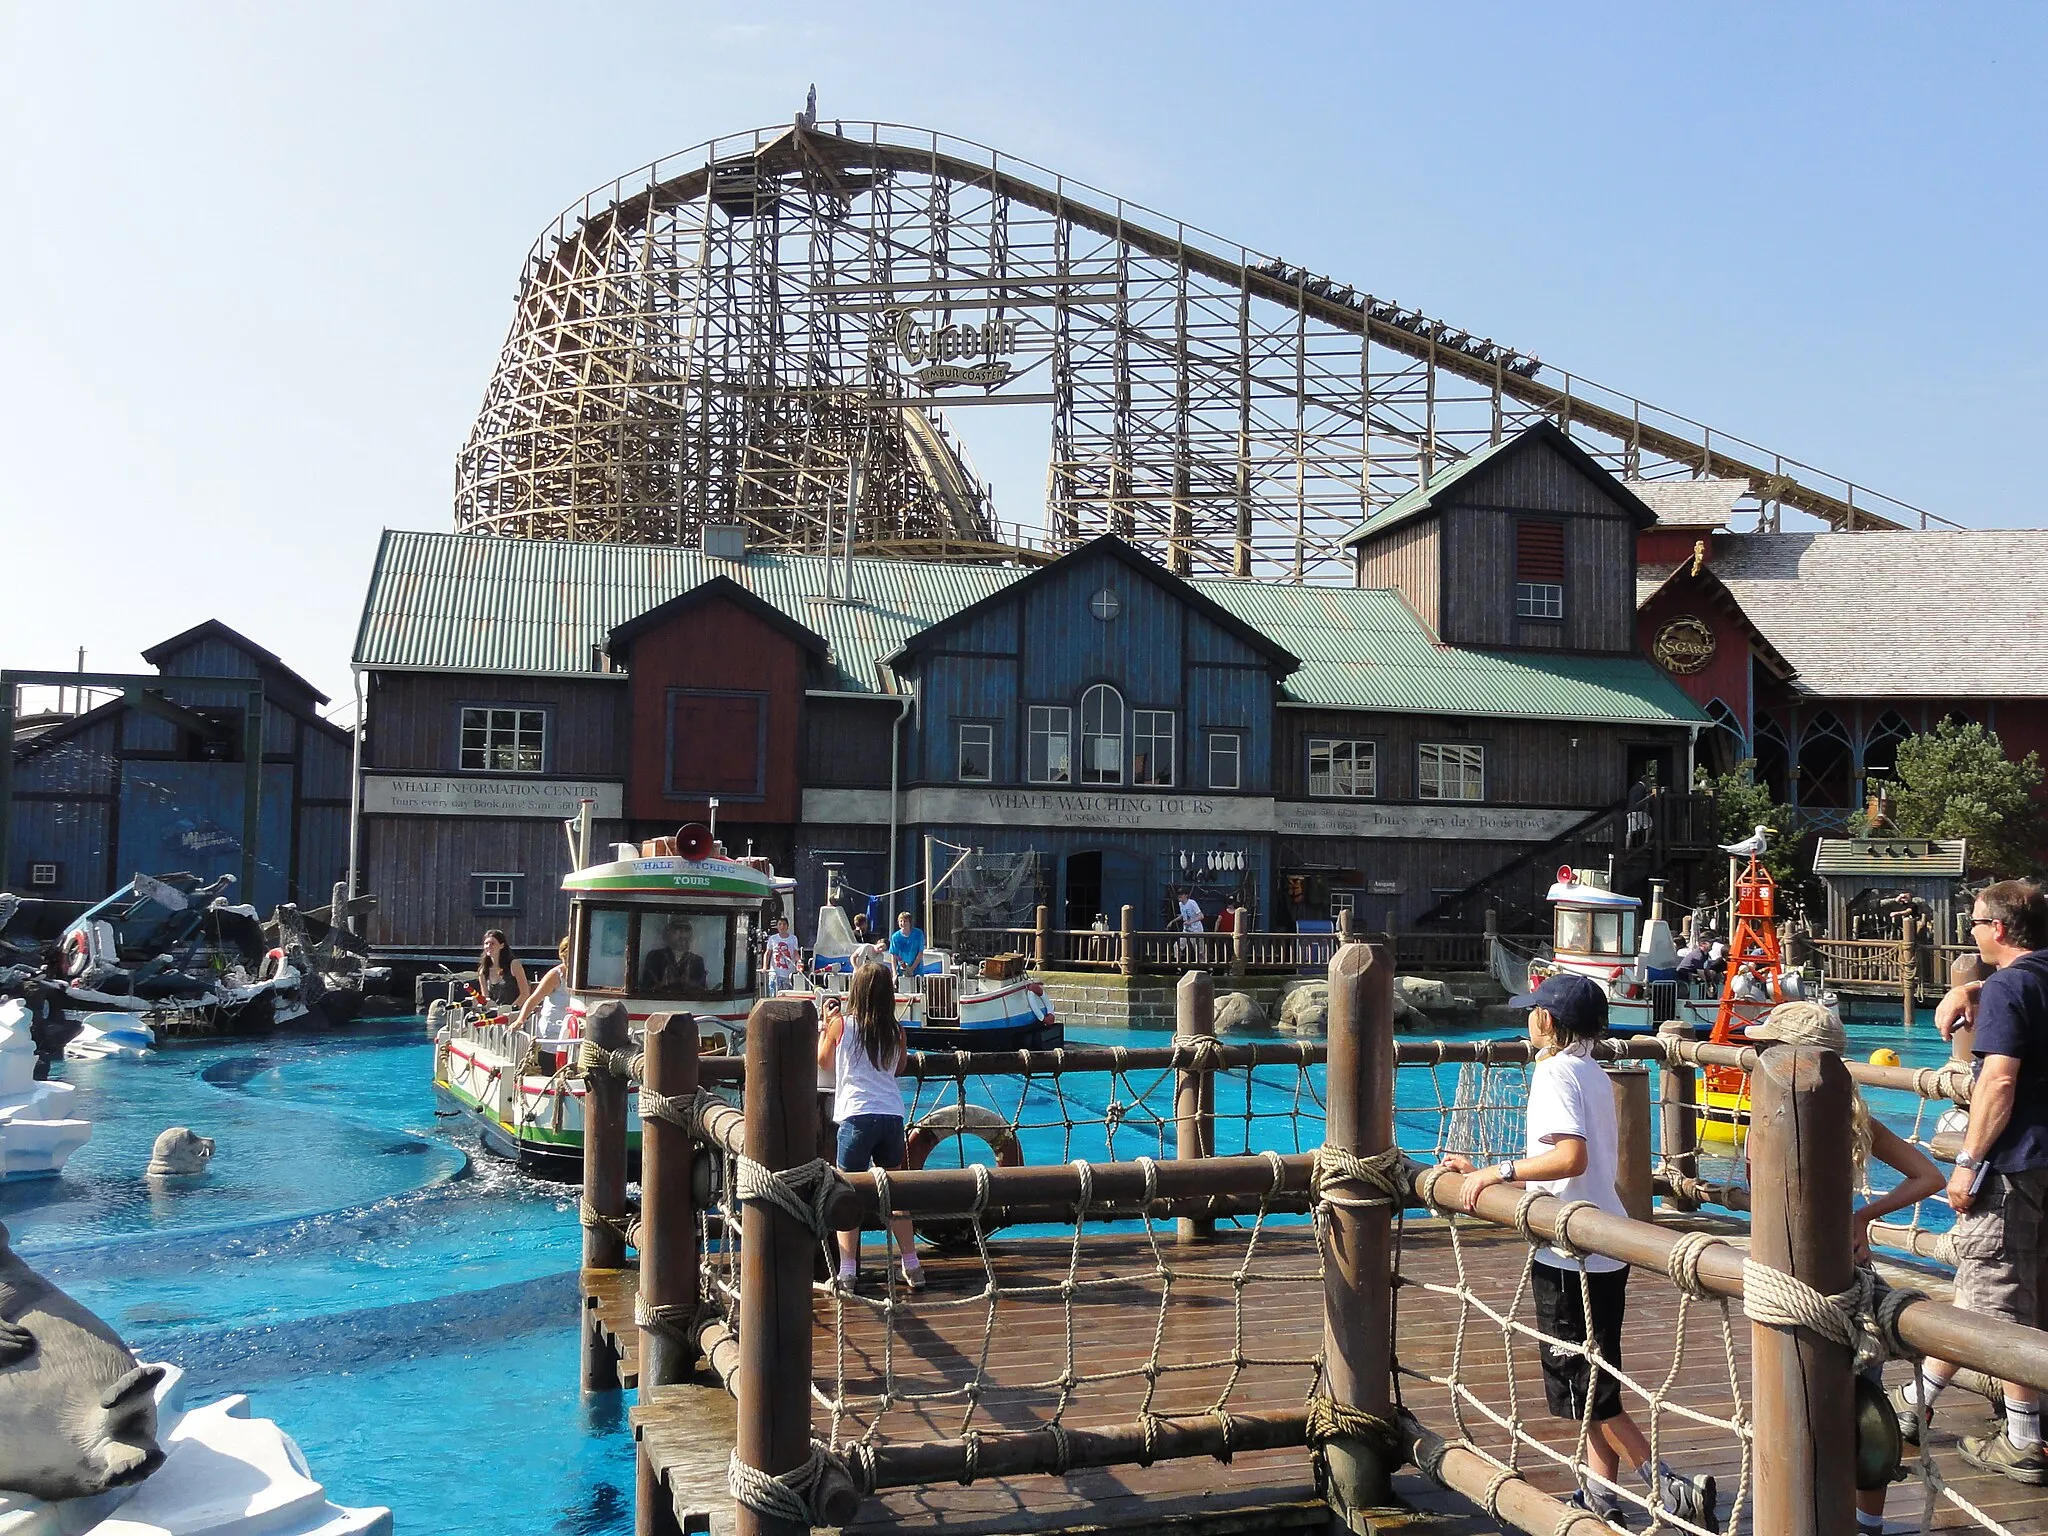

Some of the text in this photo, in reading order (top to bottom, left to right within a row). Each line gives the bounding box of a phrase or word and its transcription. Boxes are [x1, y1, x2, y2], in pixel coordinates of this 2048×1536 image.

[919, 367, 1004, 382] TIMBUR COASTER
[1657, 641, 1713, 658] ASGARD
[392, 781, 599, 797] WHALE INFORMATION CENTER
[473, 798, 500, 808] Book
[576, 801, 599, 811] 60
[988, 793, 1213, 815] WHALE WATCHING TOURS
[1064, 813, 1143, 824] AUSGANG EXIT
[1413, 816, 1445, 829] very
[633, 861, 674, 870] WHALE
[673, 876, 711, 886] TOURS
